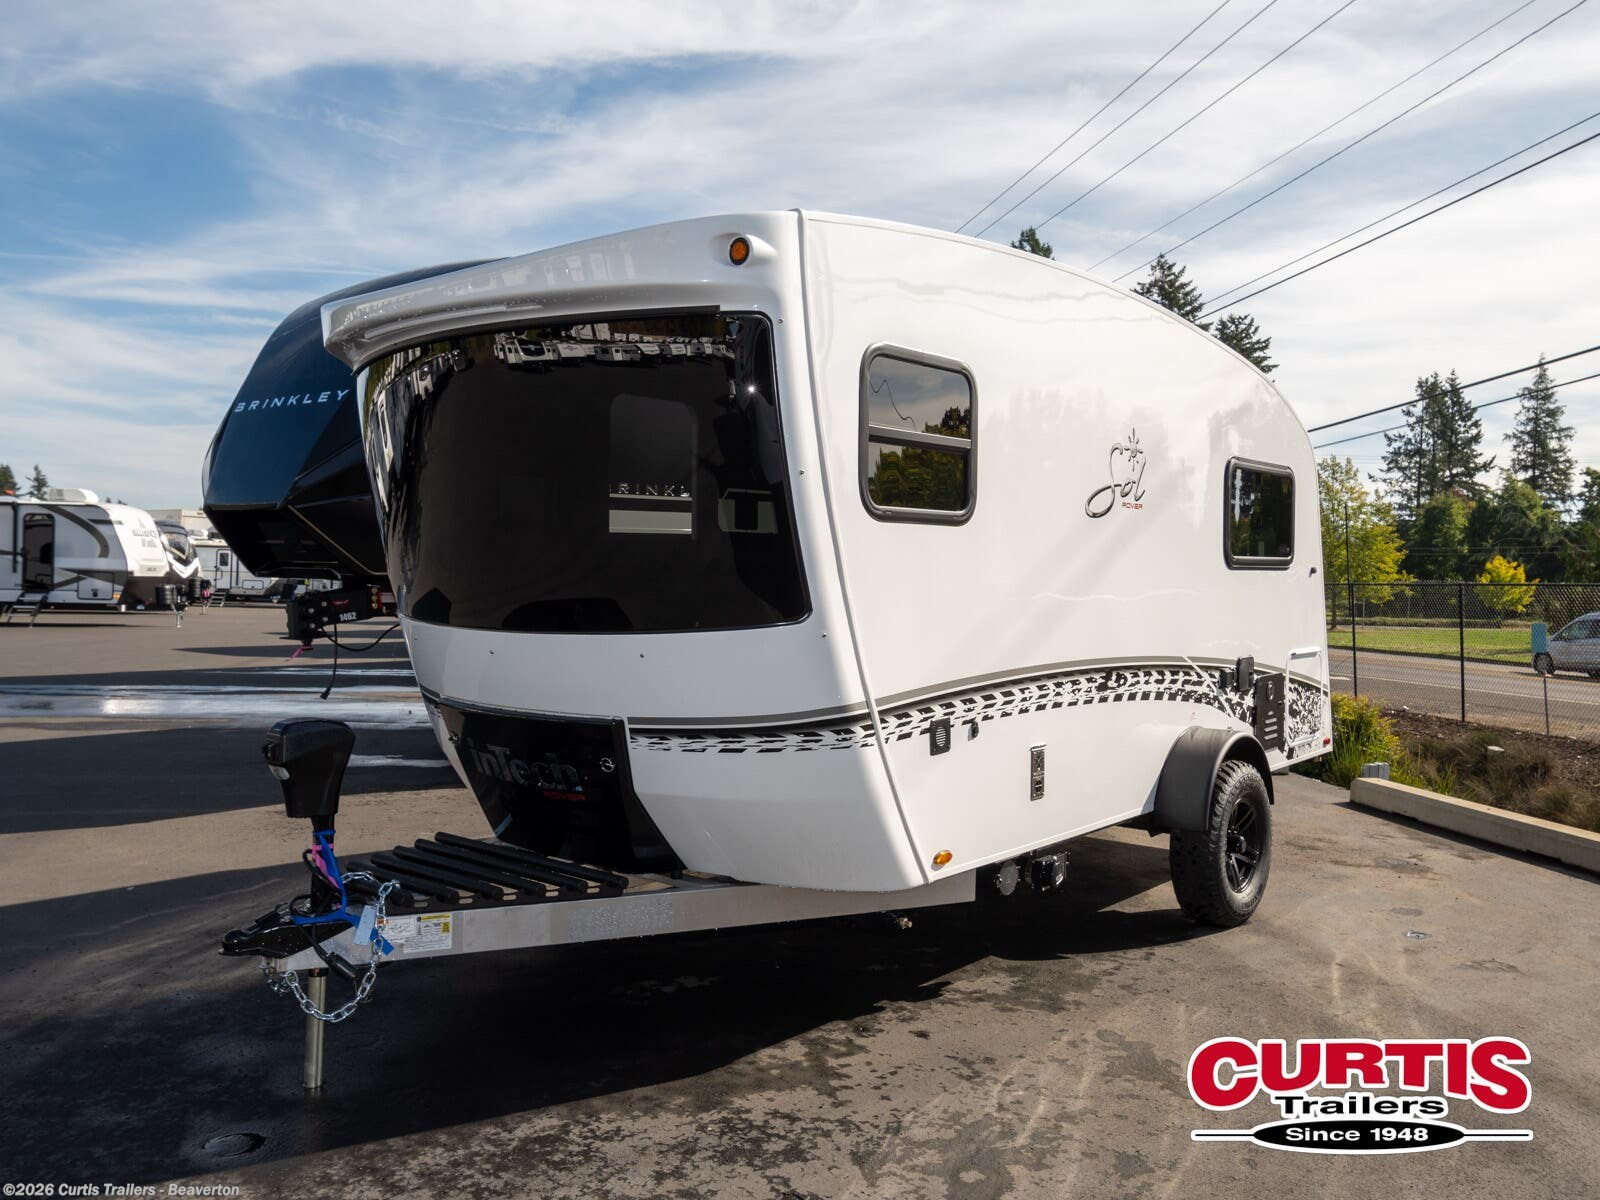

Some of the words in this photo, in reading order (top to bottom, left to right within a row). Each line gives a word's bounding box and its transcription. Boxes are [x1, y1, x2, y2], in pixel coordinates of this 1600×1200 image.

[234, 389, 350, 413] BRINKLEY
[1122, 501, 1144, 510] ROVER
[132, 528, 158, 538] ALLIANCE
